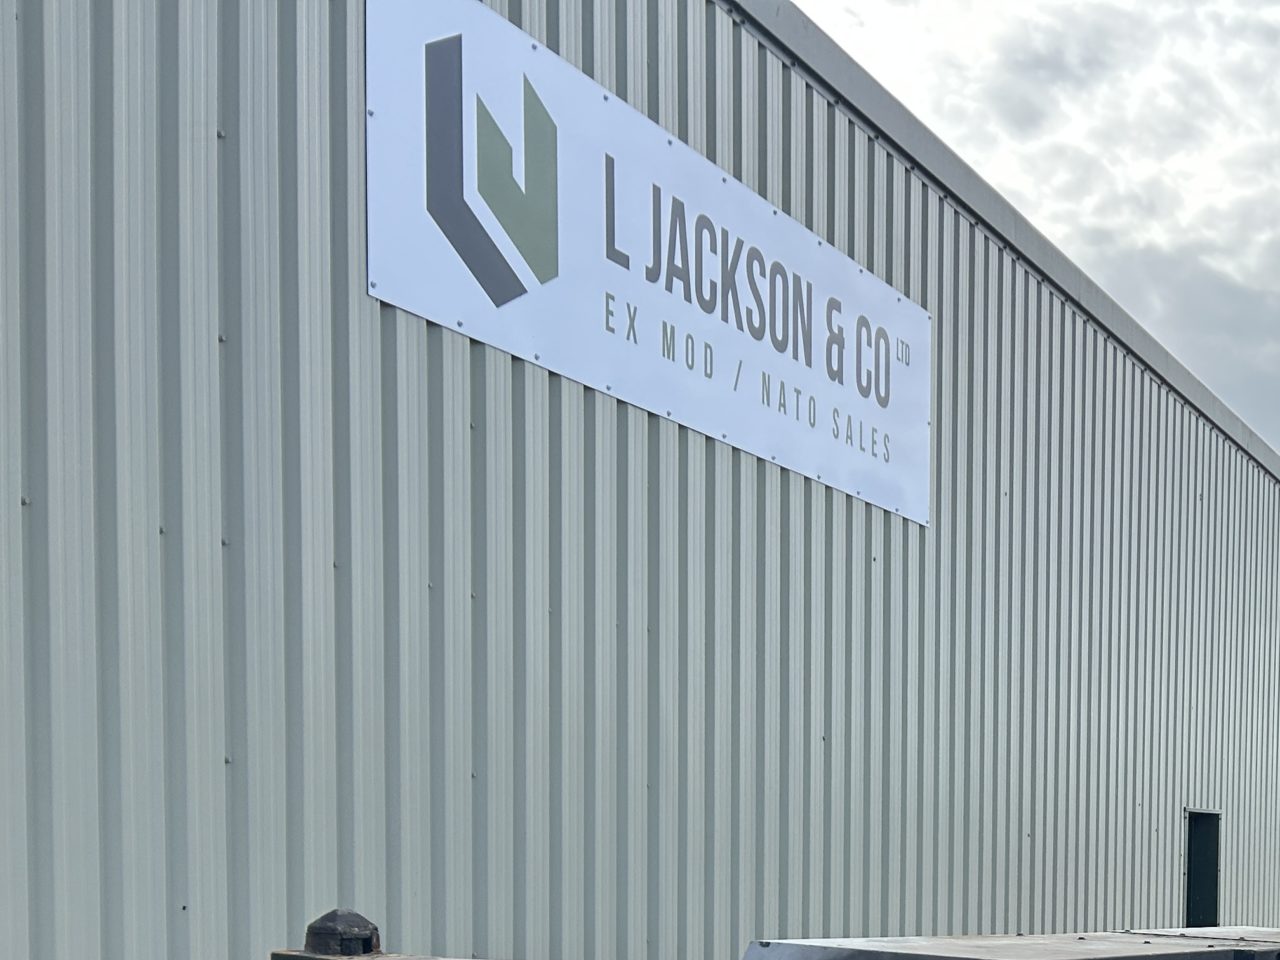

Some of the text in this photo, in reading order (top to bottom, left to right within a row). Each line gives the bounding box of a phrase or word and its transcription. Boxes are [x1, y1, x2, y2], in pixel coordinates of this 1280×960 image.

[604, 152, 911, 409] L JACKSON & CO LTD
[605, 291, 891, 463] EX MOD / NATO SALES
